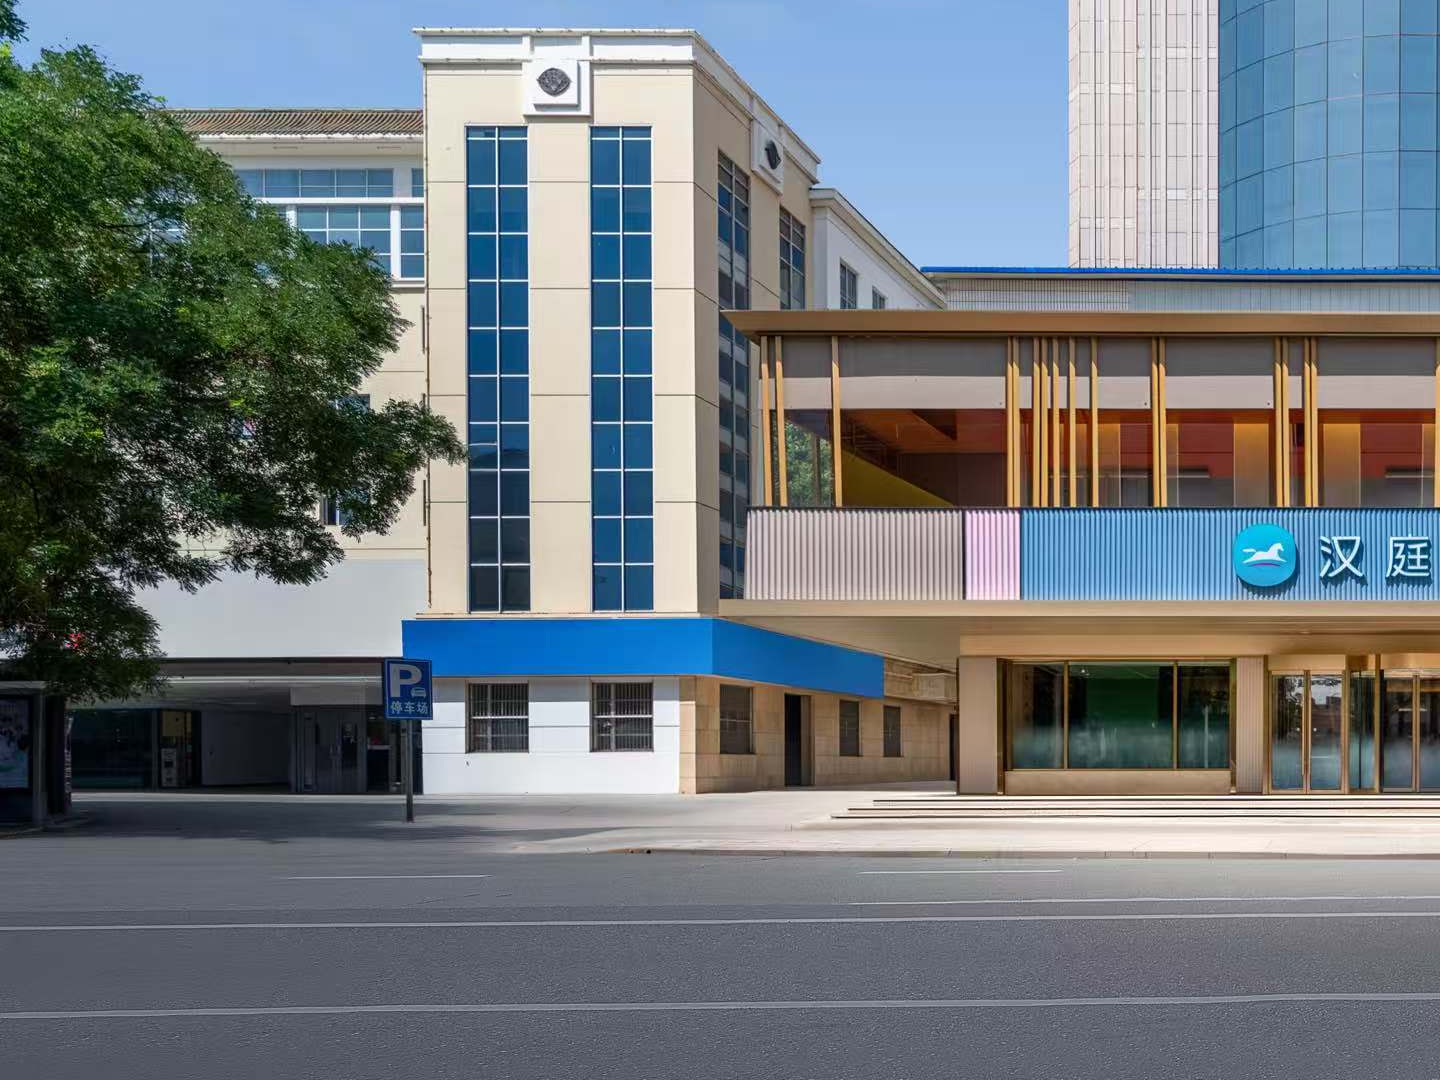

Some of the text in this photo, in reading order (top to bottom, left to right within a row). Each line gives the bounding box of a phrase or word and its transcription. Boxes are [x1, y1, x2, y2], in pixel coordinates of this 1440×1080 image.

[389, 663, 423, 698] P
[391, 700, 428, 714] 停车场
